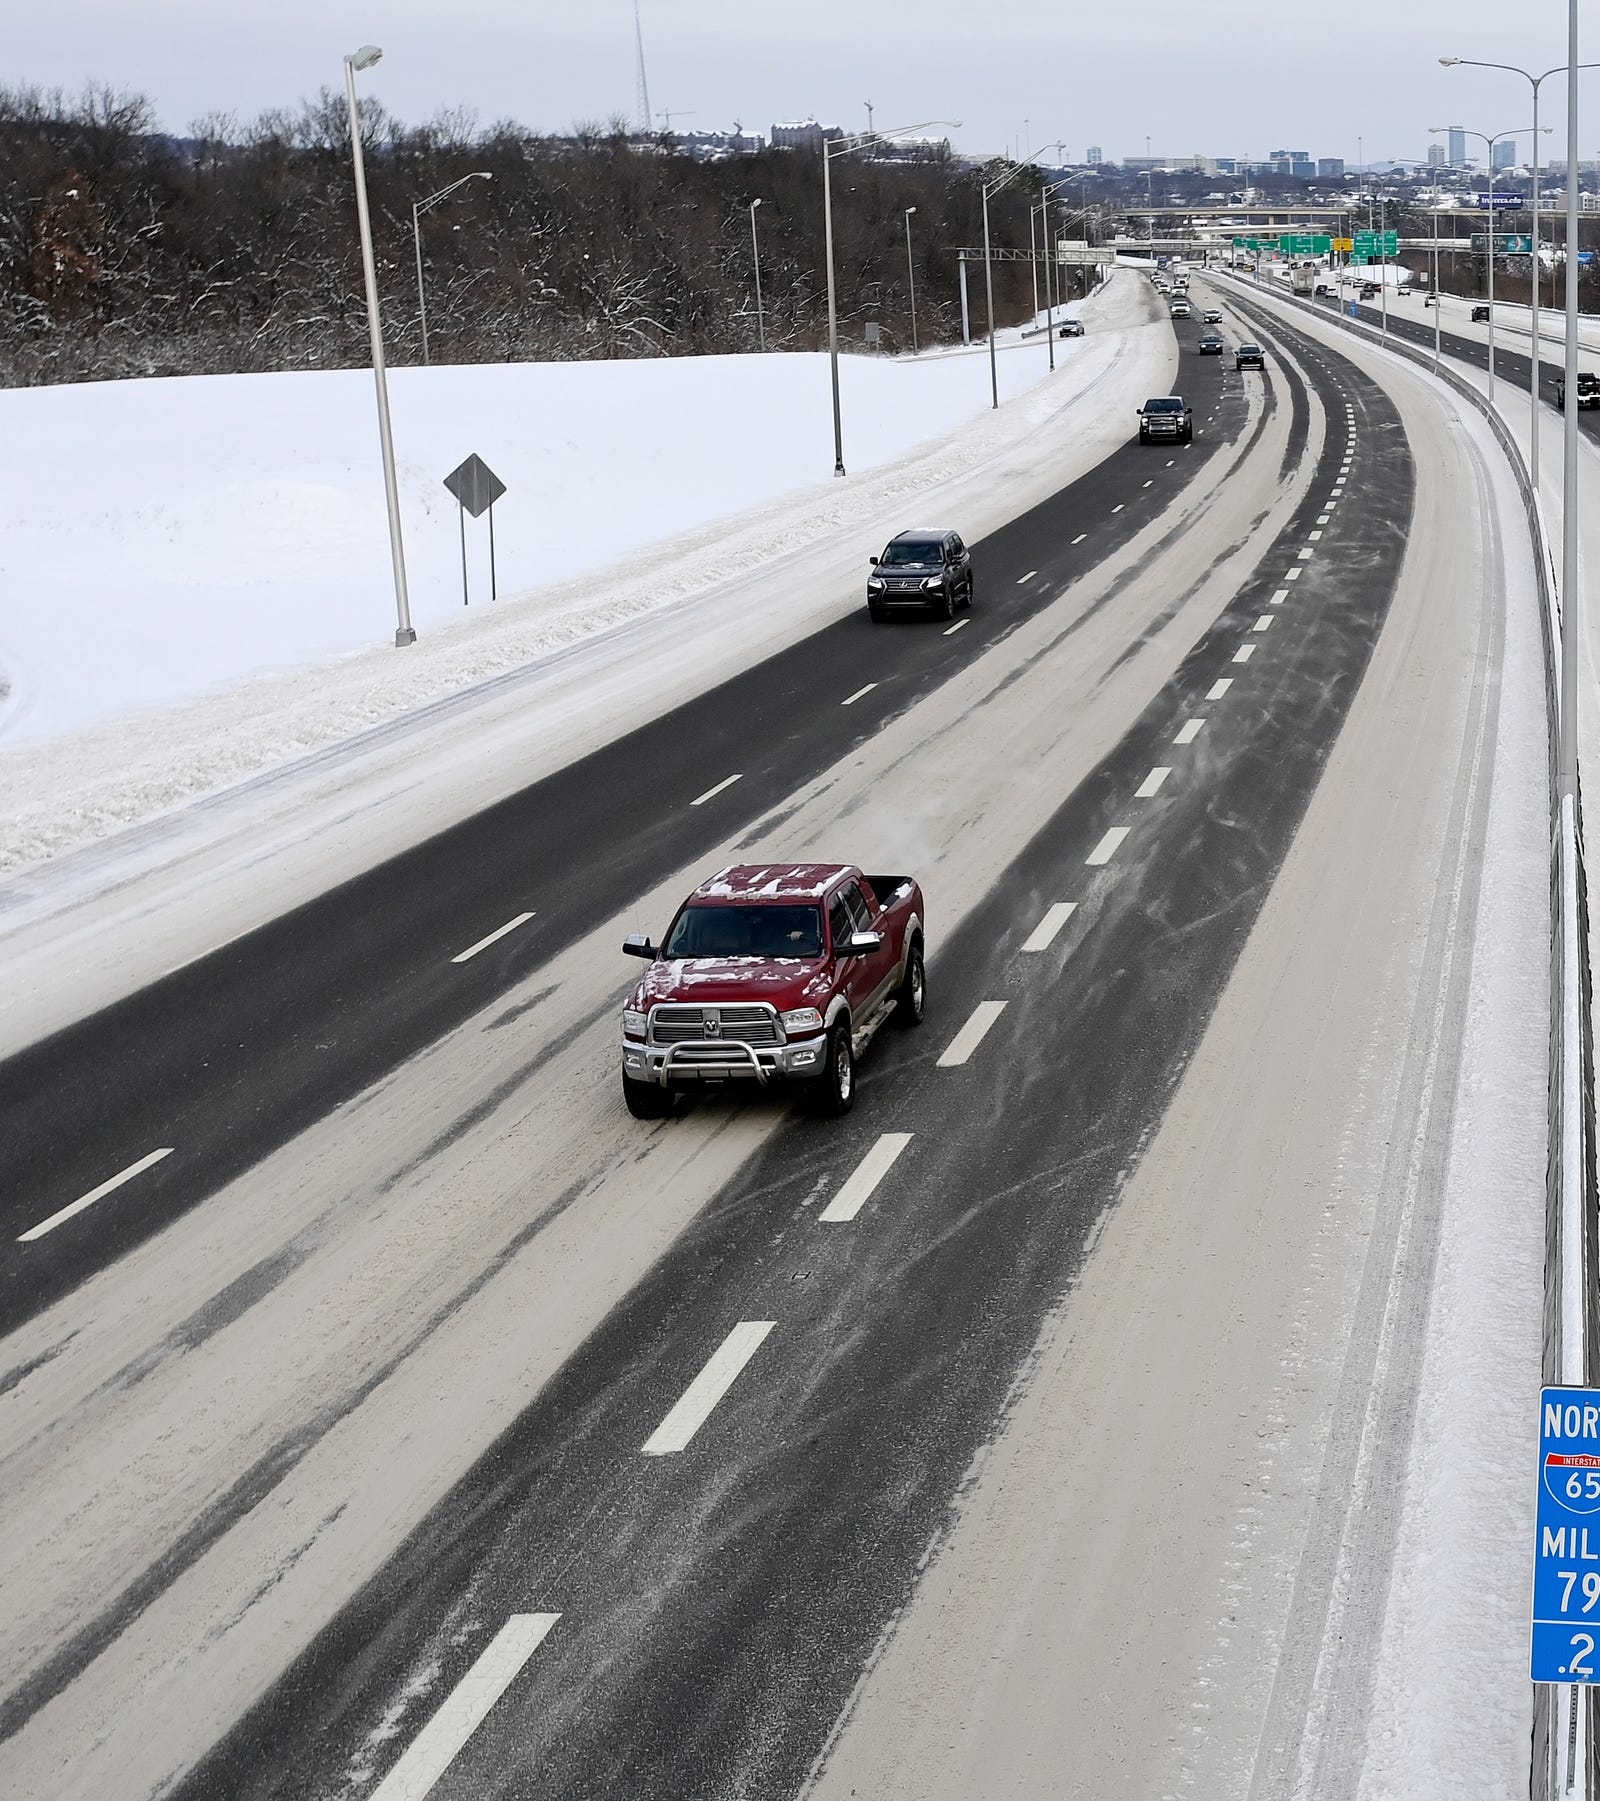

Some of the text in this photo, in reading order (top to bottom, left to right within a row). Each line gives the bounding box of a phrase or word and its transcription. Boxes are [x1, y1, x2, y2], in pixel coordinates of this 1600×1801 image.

[1565, 1472, 1600, 1499] 65
[1557, 1572, 1600, 1614] 79
[1558, 1633, 1595, 1675] .2
